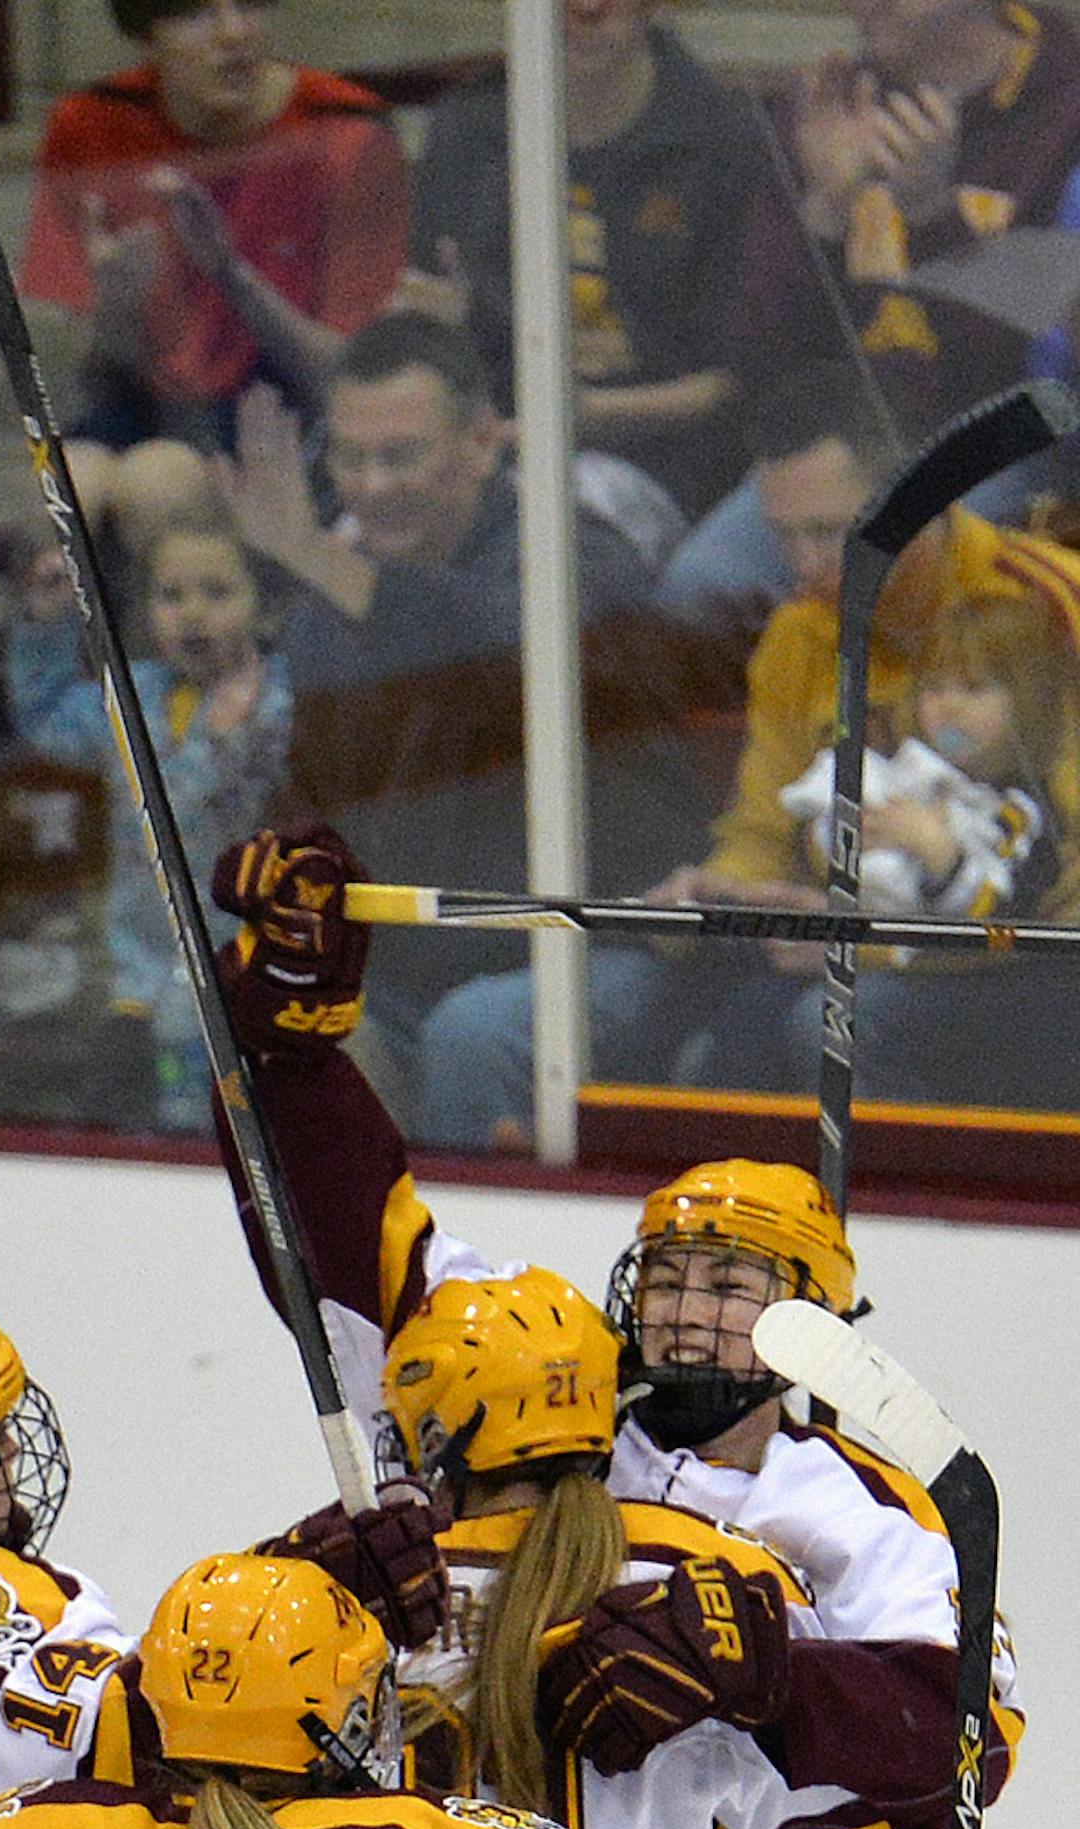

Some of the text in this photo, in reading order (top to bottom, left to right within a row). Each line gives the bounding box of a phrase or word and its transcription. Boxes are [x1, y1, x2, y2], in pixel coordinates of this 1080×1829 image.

[547, 1372, 579, 1408] 21
[682, 1557, 744, 1663] UER
[0, 1638, 120, 1750] 14
[190, 1647, 231, 1683] 22
